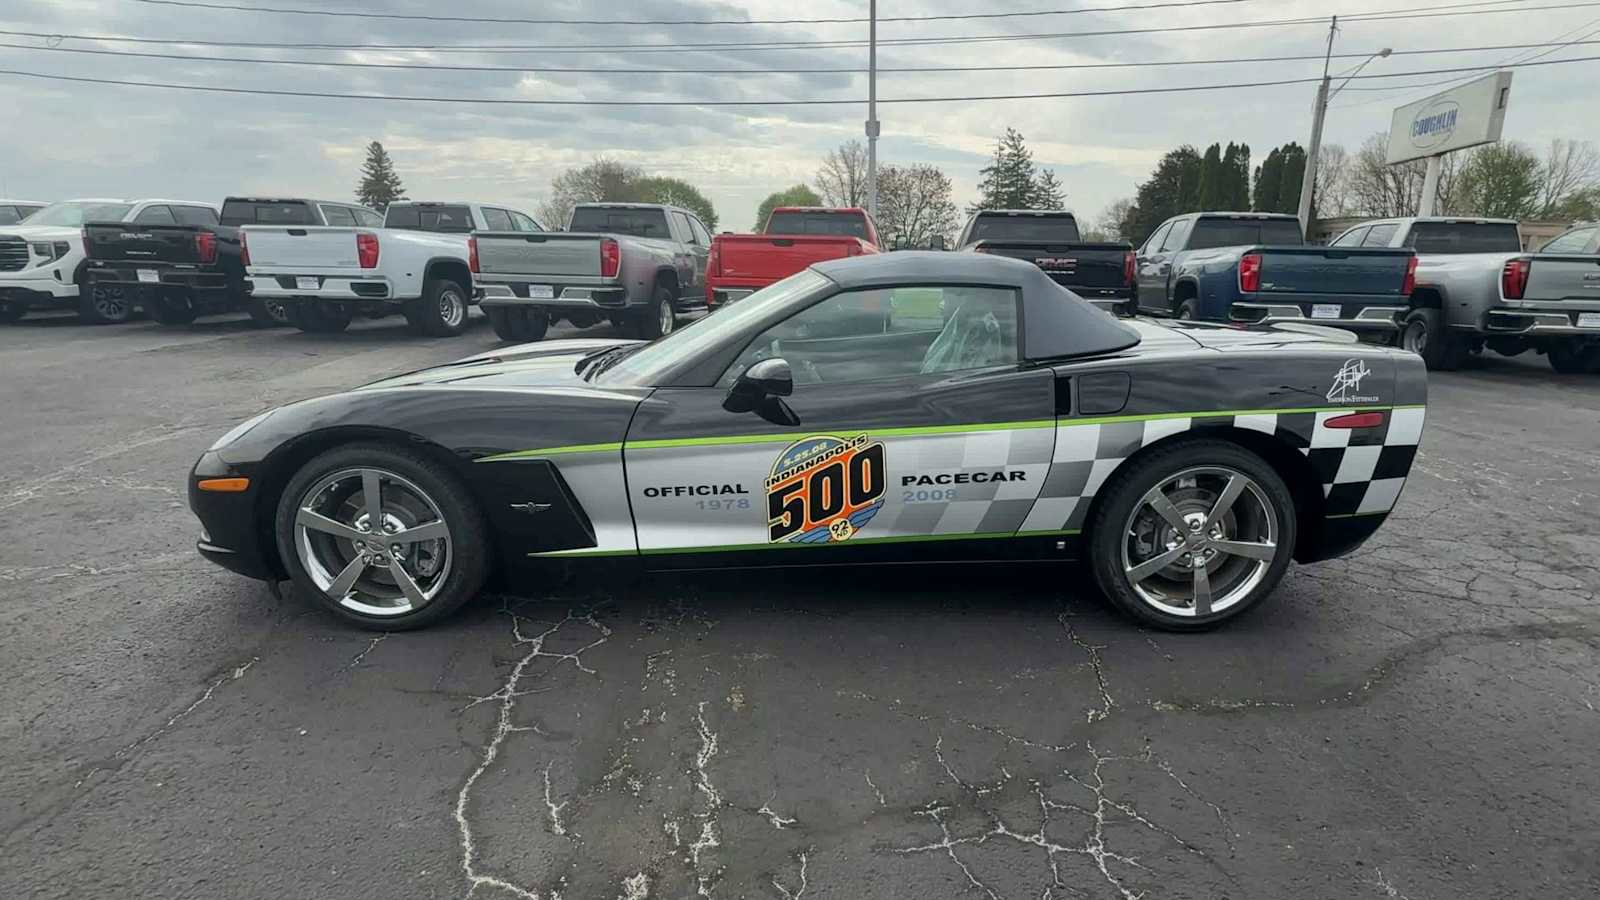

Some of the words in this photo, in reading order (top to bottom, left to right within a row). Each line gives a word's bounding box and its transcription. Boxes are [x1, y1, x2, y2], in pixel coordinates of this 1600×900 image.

[1412, 108, 1458, 137] COUGHLIN
[765, 434, 866, 487] INDIANAPOLIS
[643, 483, 749, 498] OFFICIAL
[901, 470, 1027, 487] PACECAR
[768, 443, 885, 542] 500
[695, 498, 750, 511] 1978
[902, 488, 958, 502] 2008
[831, 520, 848, 534] 92
